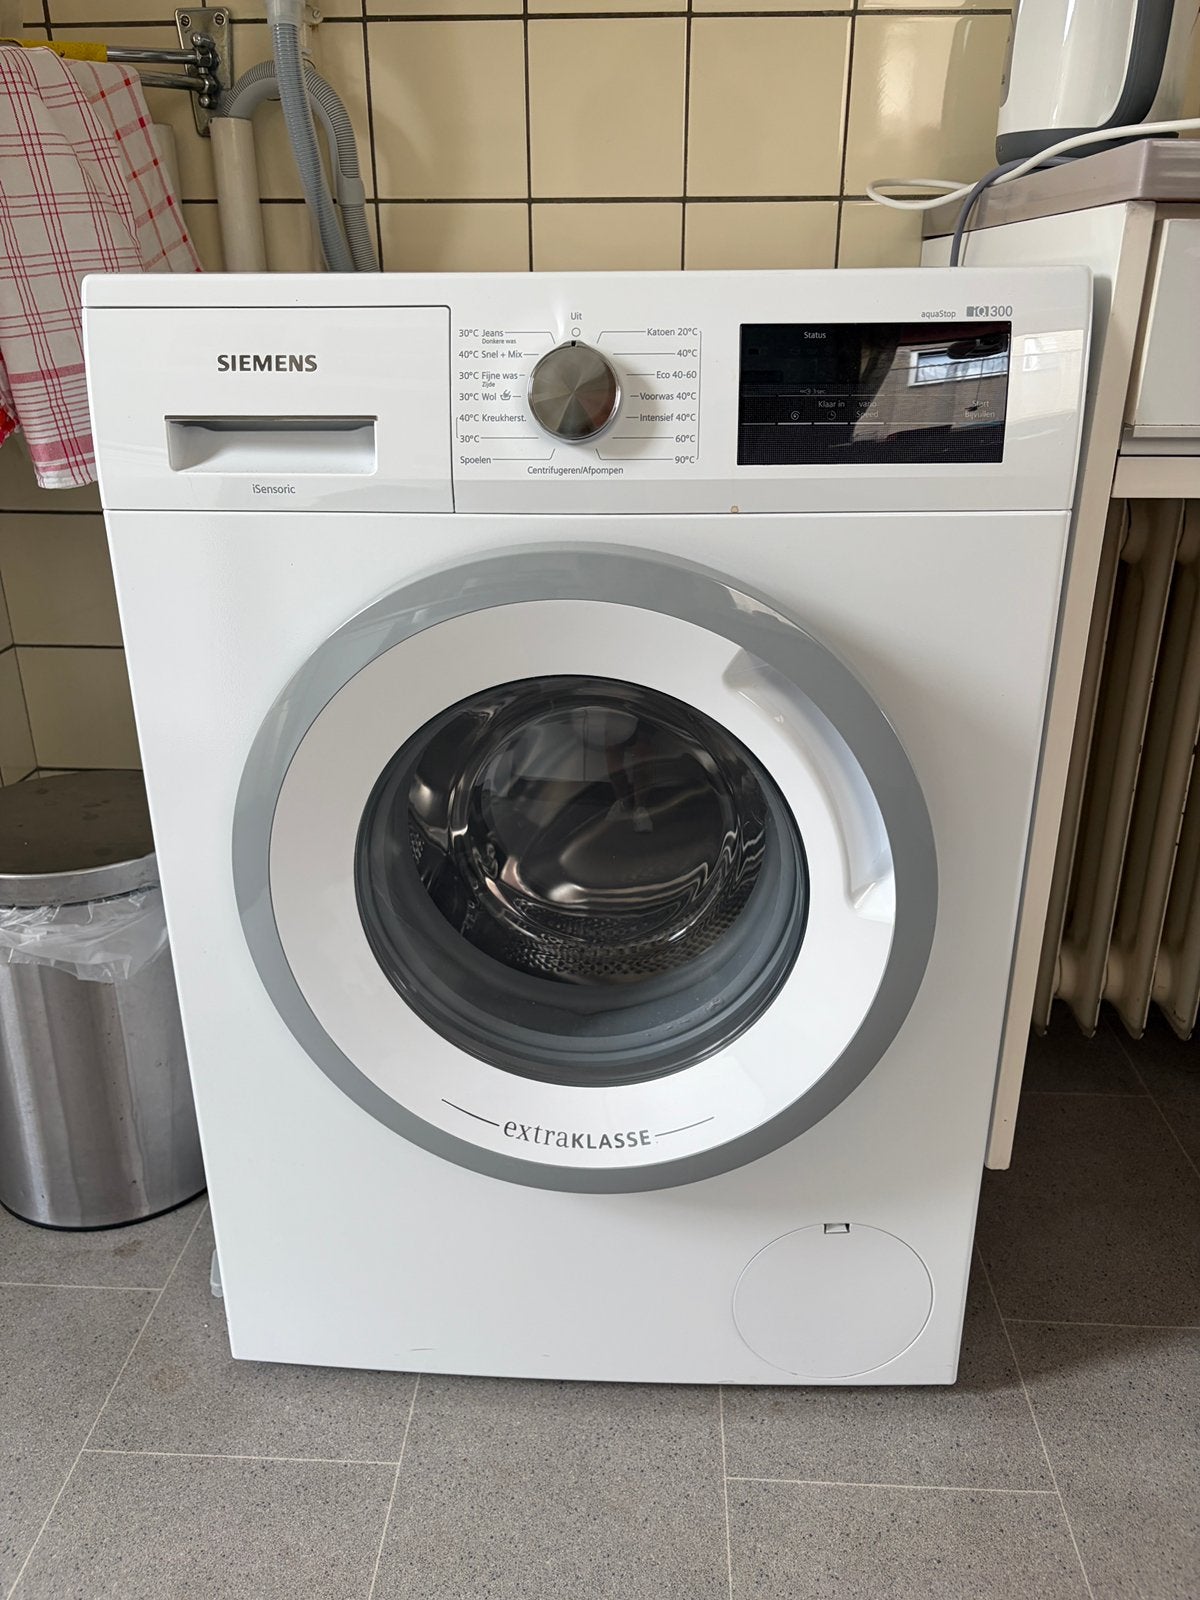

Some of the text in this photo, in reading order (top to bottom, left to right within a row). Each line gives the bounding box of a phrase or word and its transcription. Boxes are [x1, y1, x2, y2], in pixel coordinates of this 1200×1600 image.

[570, 312, 582, 321] Uit
[921, 310, 956, 319] aquaStop
[459, 329, 504, 337] 30°C Jeans
[647, 328, 698, 336] Katoen 20°C
[803, 331, 827, 339] Status
[458, 350, 479, 359] 40°C
[481, 350, 498, 358] Snel
[507, 350, 523, 358] Mix
[676, 349, 698, 358] 40°C
[217, 354, 318, 373] SIEMENS
[459, 371, 479, 380] 30°C
[481, 371, 501, 381] Fijne
[656, 371, 697, 379] Eco 40-60
[459, 393, 497, 401] 30°C Wol
[639, 392, 697, 401] Voorwas 40°C
[818, 400, 846, 408] Klaar in
[459, 414, 527, 423] 40°C Kreukherst.
[639, 413, 696, 422] Intensief 40°C
[459, 435, 480, 443] 30°C
[675, 434, 696, 443] 60°C
[460, 455, 492, 465] Spoelen
[674, 455, 696, 464] 90°C
[527, 466, 624, 477] Centrifugeren/Afpompen
[252, 483, 296, 494] iSensoric
[503, 1119, 651, 1150] extraKLASSE
